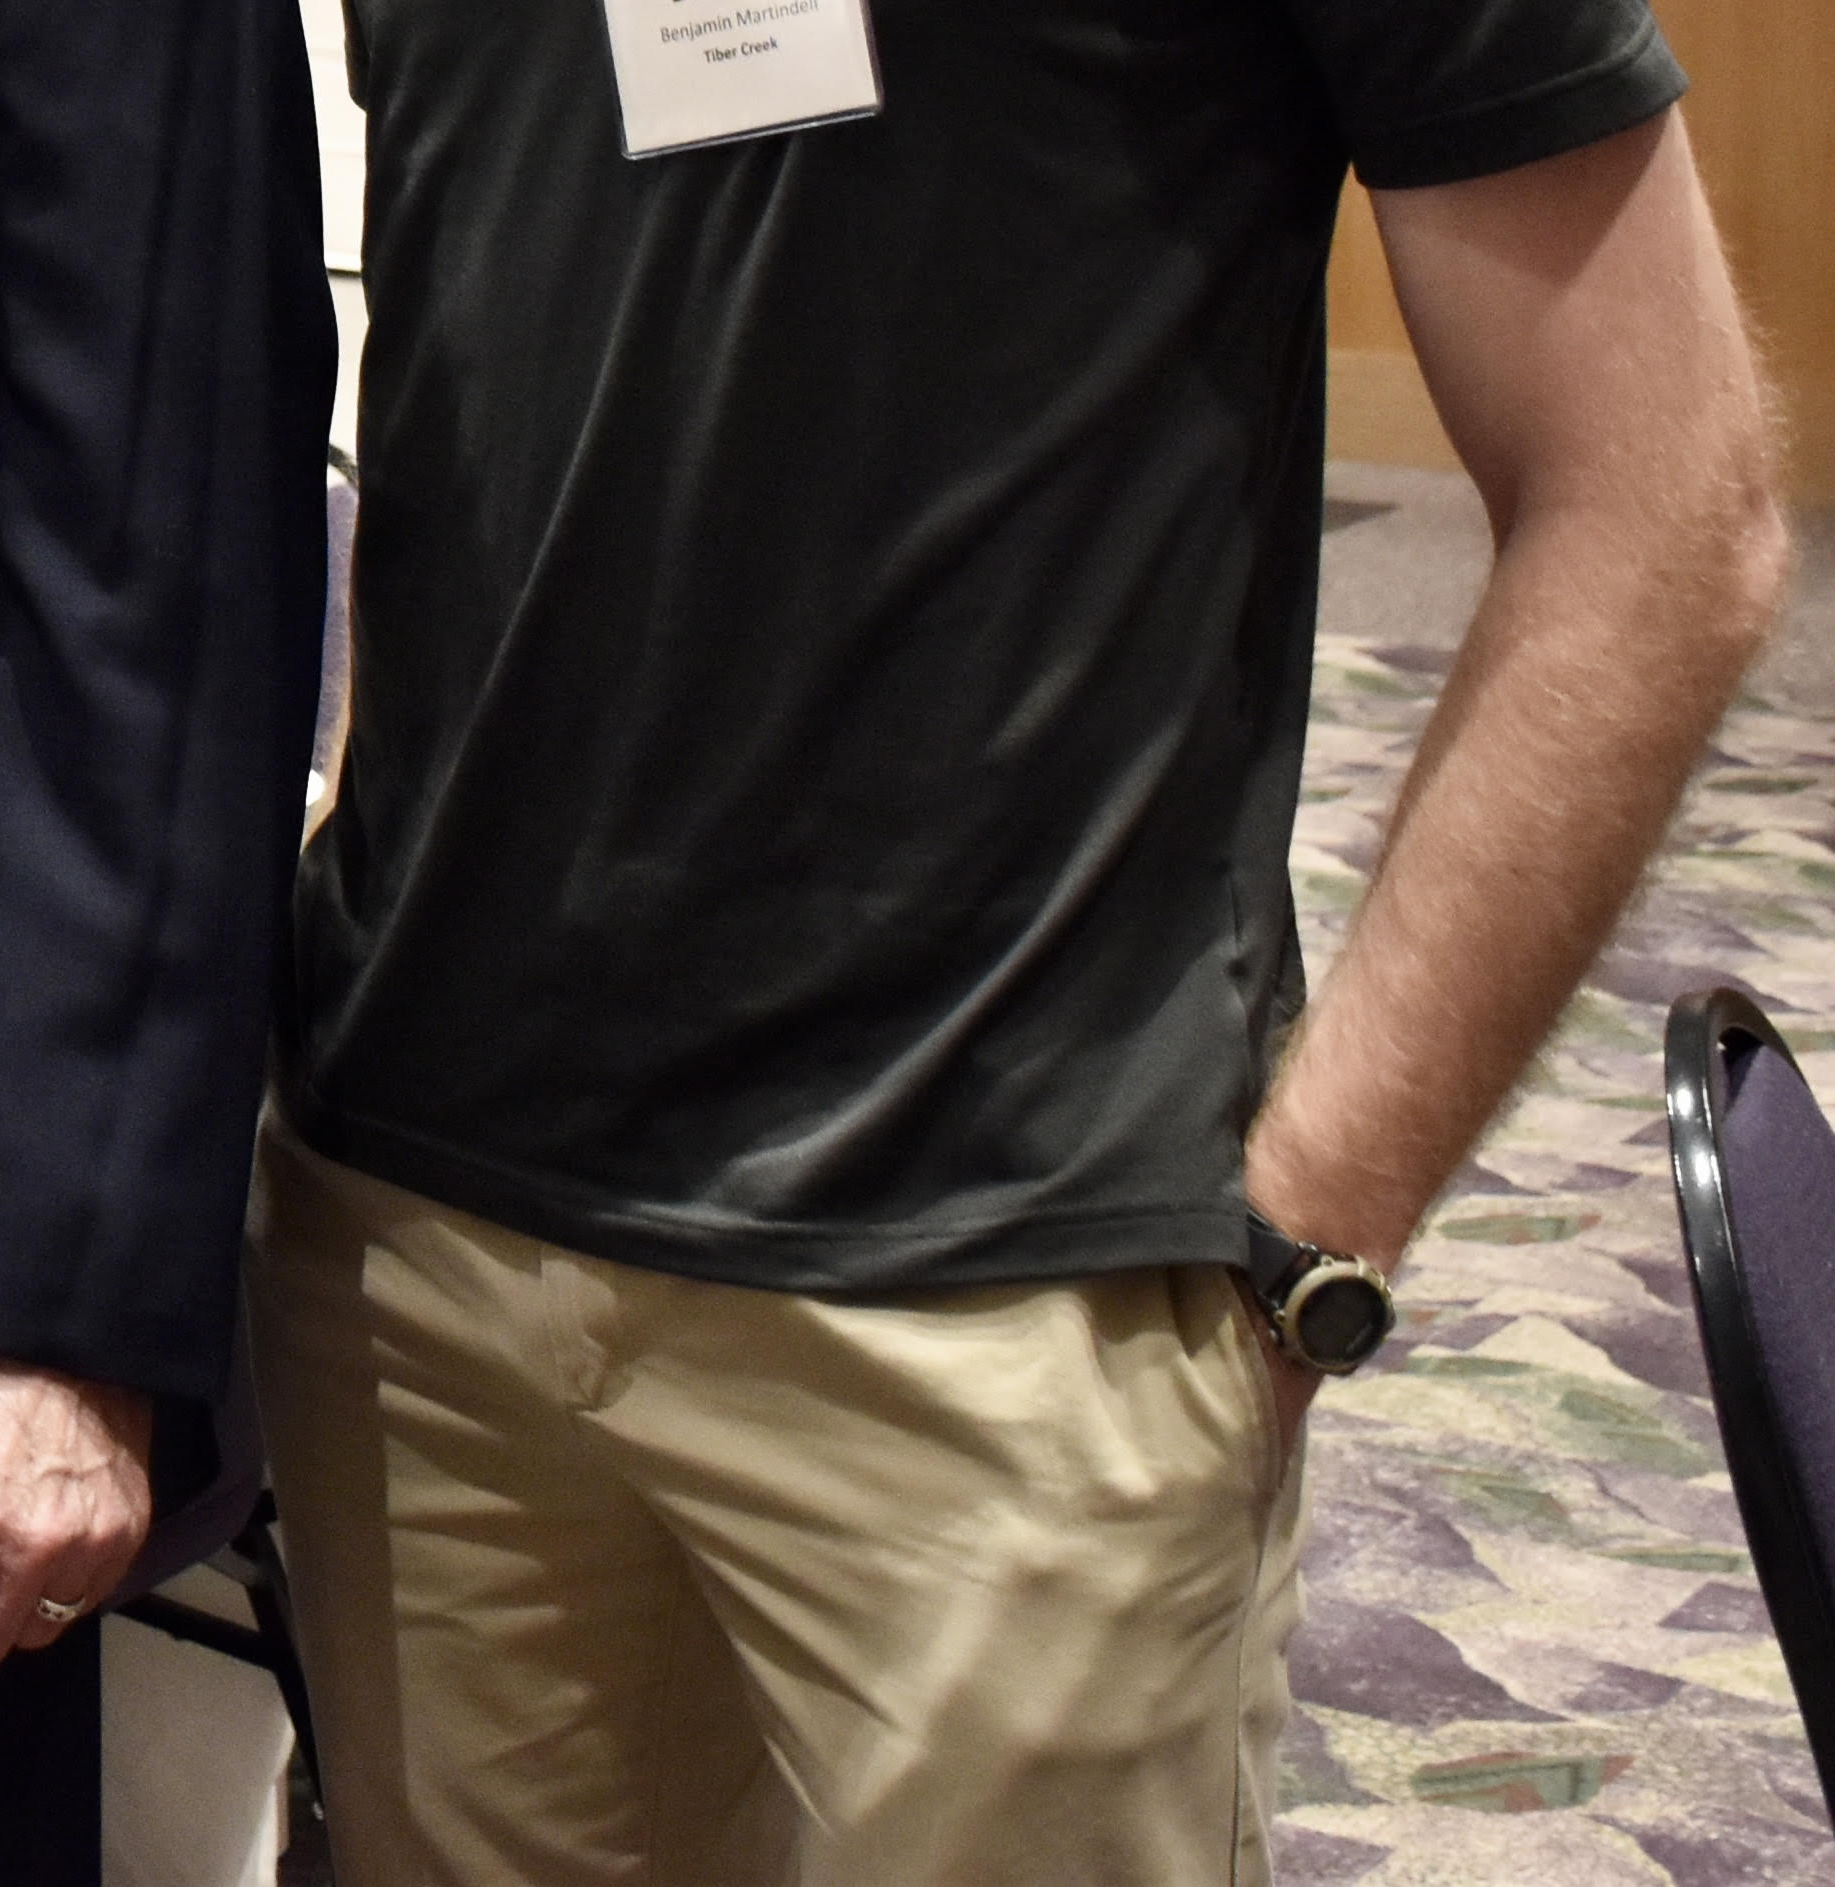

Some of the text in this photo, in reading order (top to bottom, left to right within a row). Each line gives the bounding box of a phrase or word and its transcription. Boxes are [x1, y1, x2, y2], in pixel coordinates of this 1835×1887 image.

[660, 15, 732, 43] Benjamin
[704, 37, 779, 64] Tiber Creek
